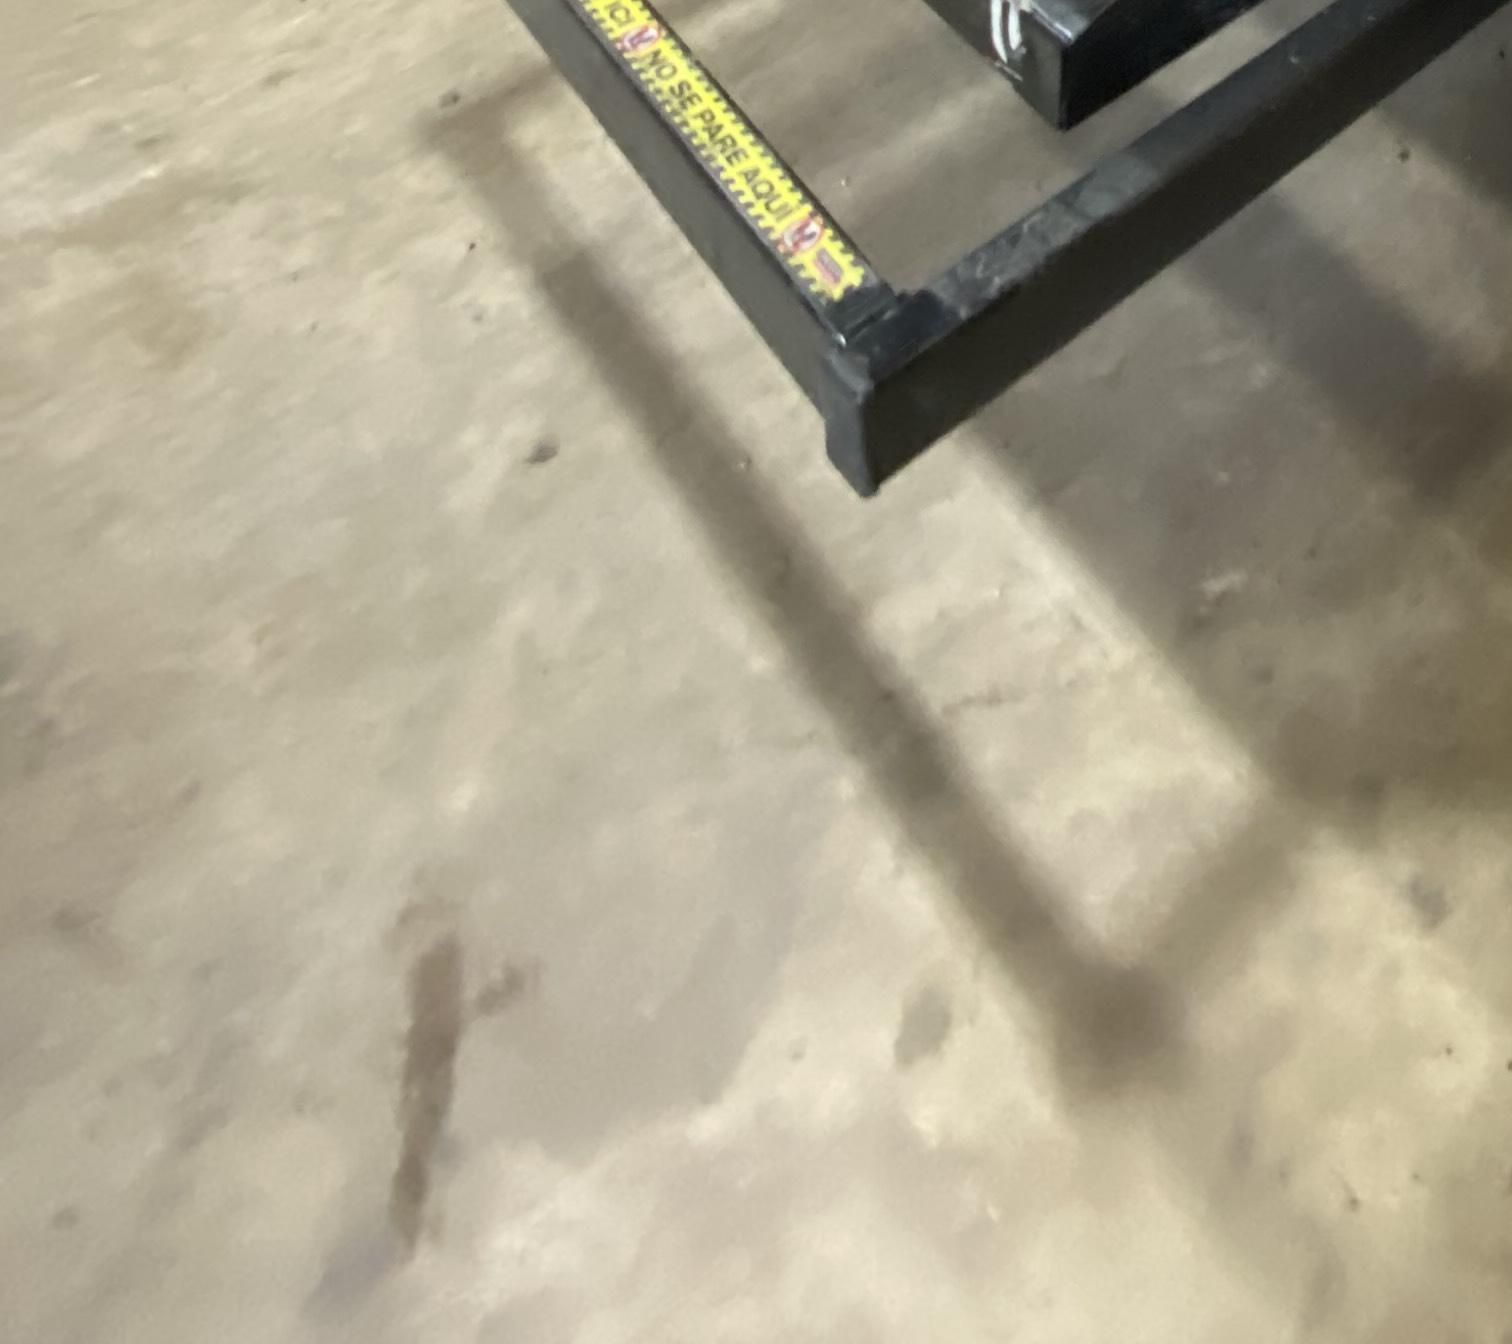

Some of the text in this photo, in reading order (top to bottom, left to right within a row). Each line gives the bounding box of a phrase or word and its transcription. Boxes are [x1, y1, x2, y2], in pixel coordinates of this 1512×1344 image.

[606, 0, 637, 29] ICI
[647, 48, 678, 81] NO
[669, 80, 703, 110] SE
[697, 109, 750, 166] PARE
